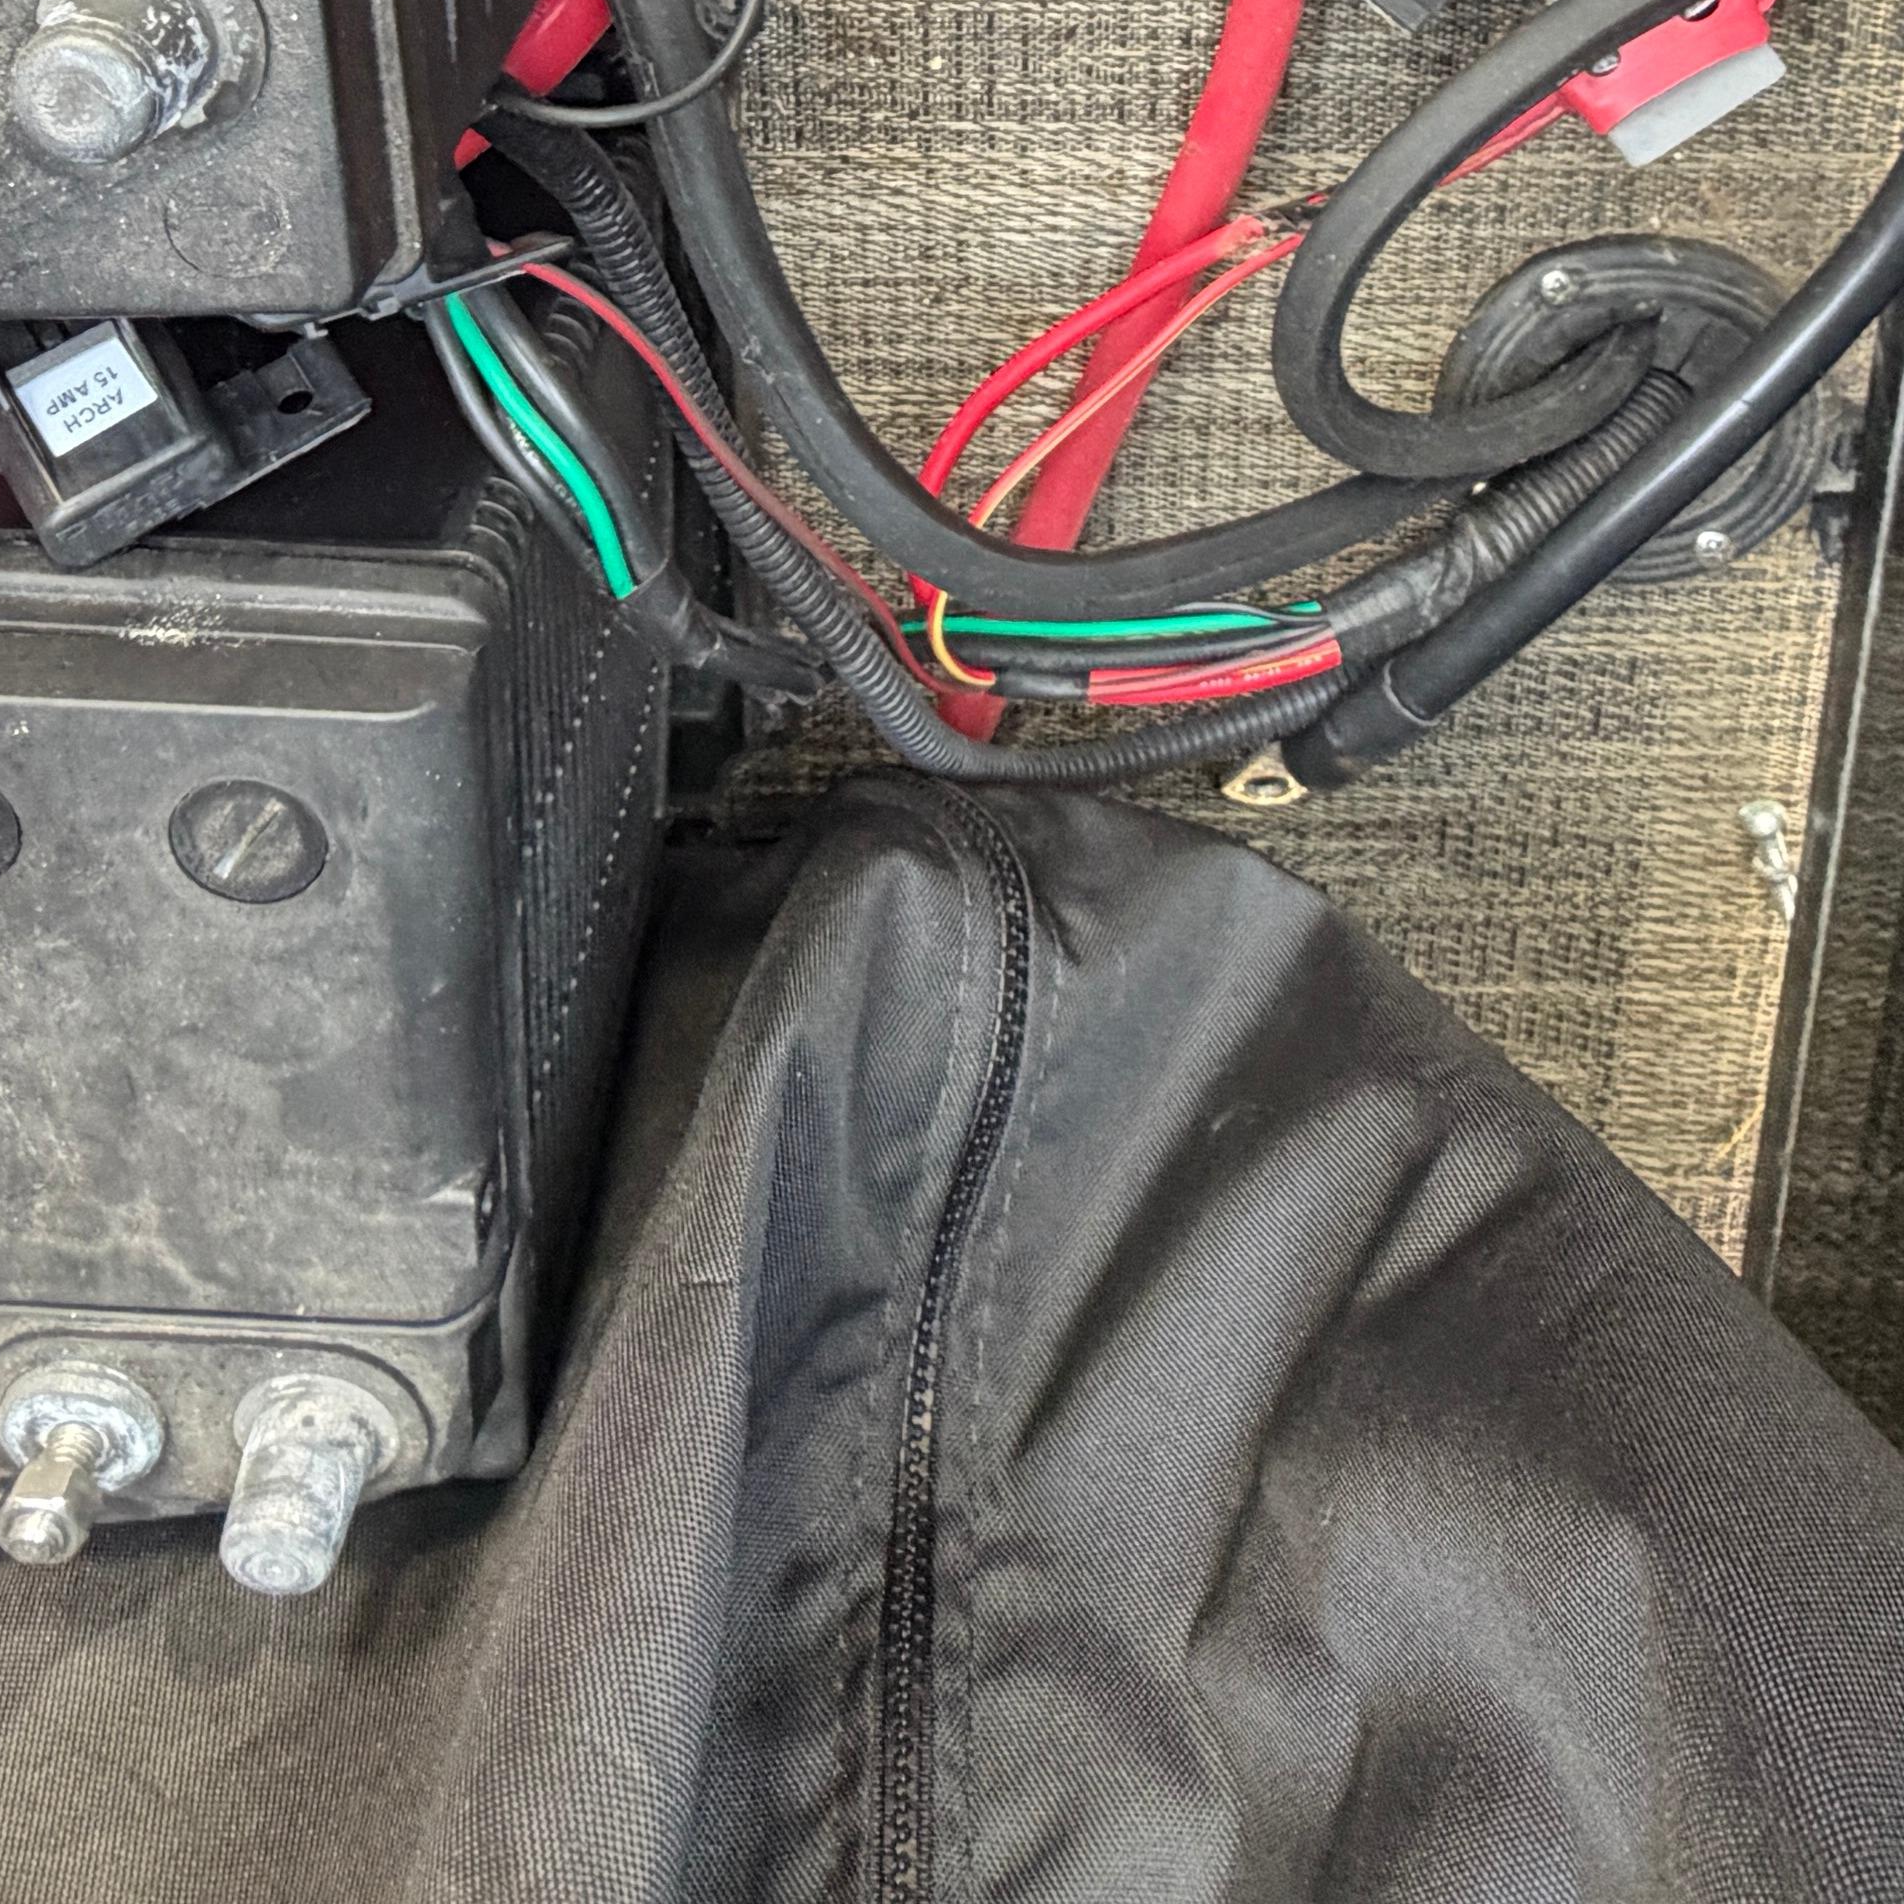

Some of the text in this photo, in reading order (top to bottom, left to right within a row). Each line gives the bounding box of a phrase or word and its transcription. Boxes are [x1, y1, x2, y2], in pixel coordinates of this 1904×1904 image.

[46, 366, 118, 415] 15 AMP
[63, 388, 124, 433] ARCH
